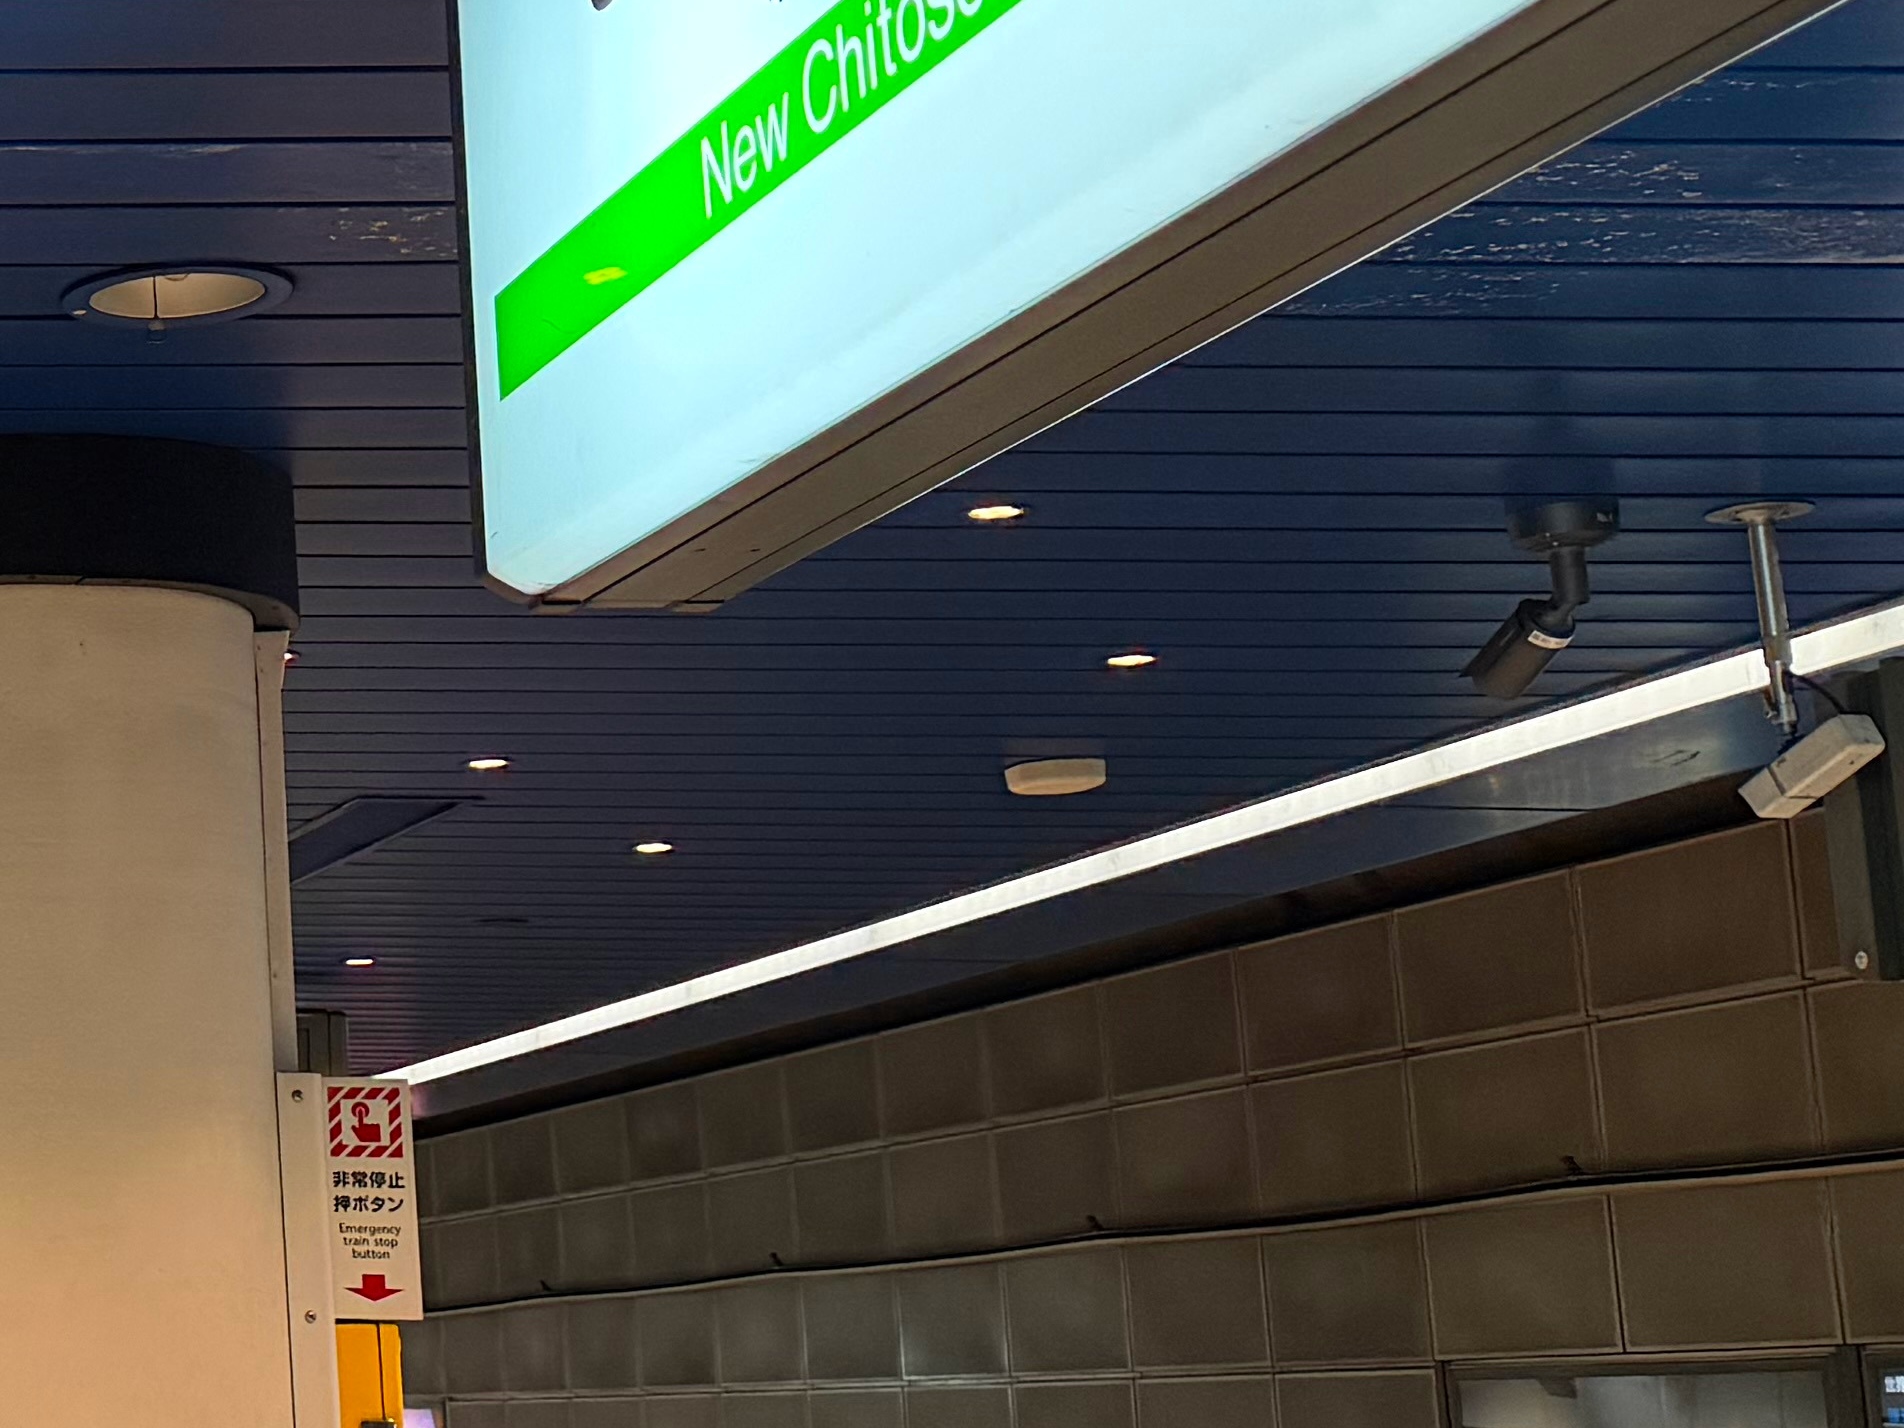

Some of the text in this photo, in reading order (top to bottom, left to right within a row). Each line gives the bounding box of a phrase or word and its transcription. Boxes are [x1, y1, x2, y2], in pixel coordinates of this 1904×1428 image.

[700, 92, 790, 219] New
[332, 1171, 405, 1189] 非常停止
[333, 1195, 404, 1213] 押ボタン
[339, 1223, 401, 1237] Emergency
[343, 1236, 398, 1250] train stop
[352, 1248, 390, 1259] button
